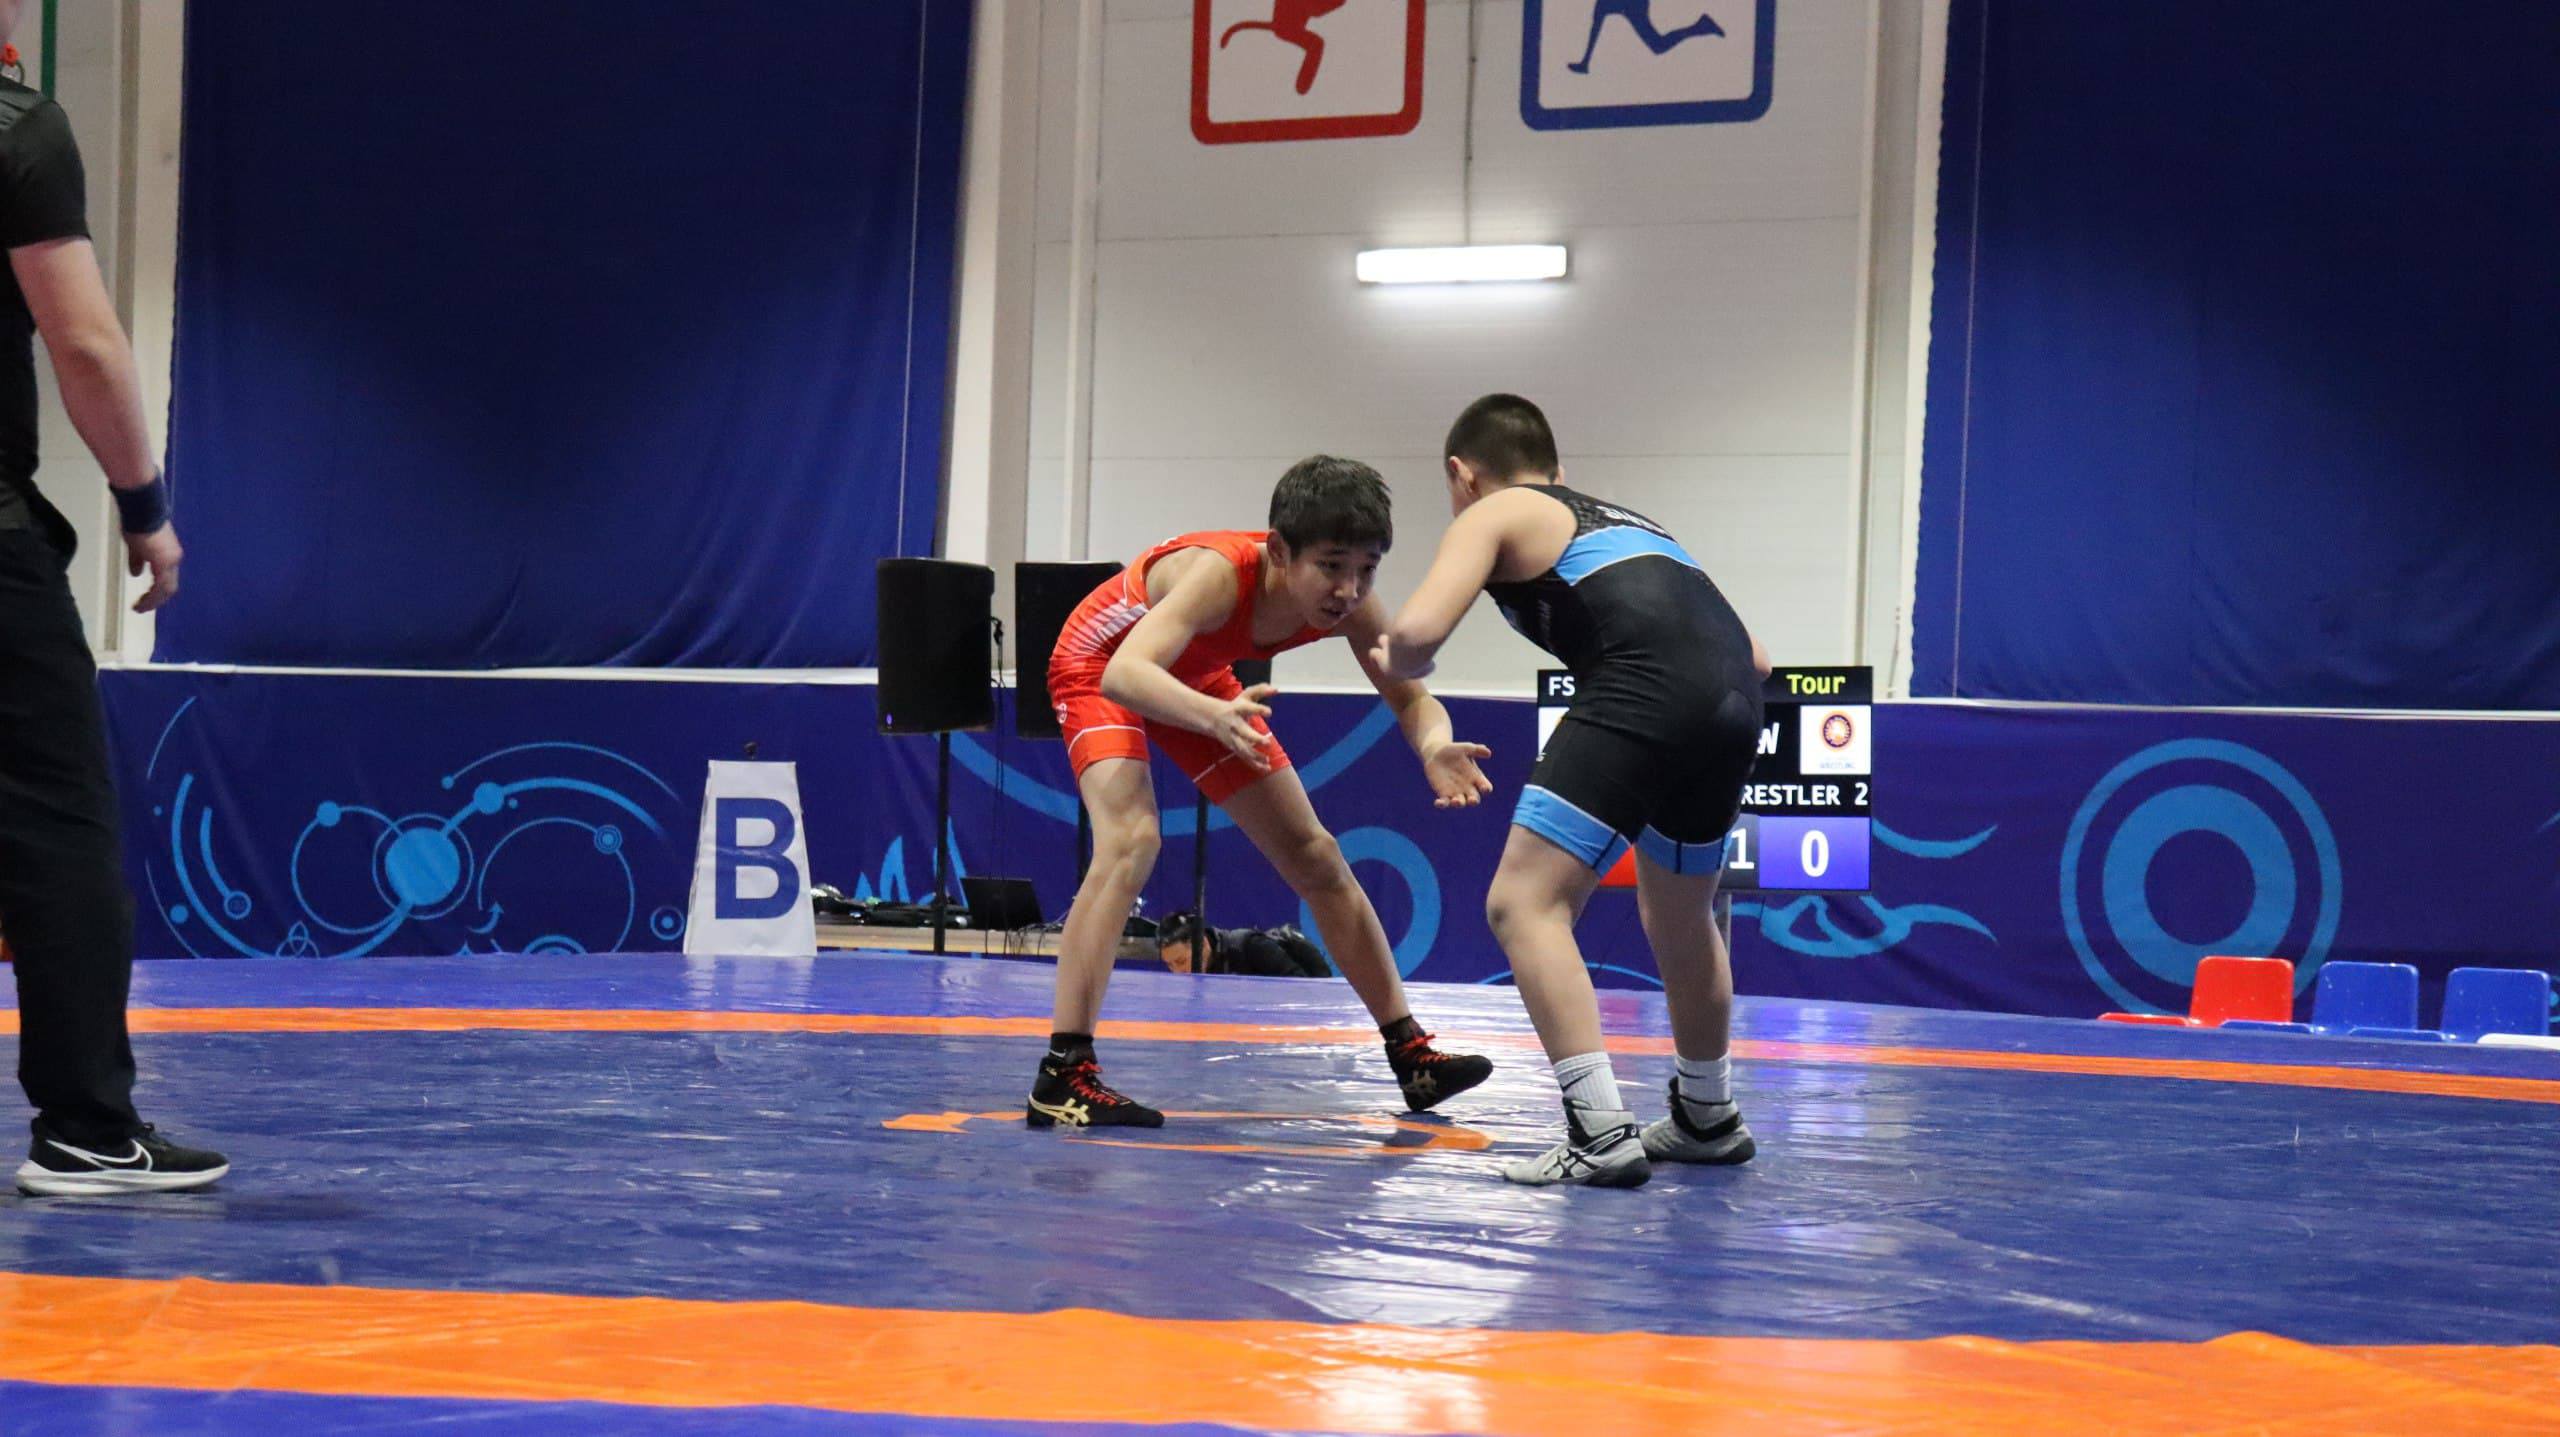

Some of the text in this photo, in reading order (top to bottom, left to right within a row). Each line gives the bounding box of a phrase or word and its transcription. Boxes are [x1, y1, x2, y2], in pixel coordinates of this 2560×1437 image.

[1548, 675, 1576, 697] FS
[1785, 673, 1847, 695] Tour
[1740, 781, 1869, 806] RESTLER 2
[715, 797, 800, 920] B
[1728, 827, 1756, 870] 1
[1800, 829, 1830, 877] 0
